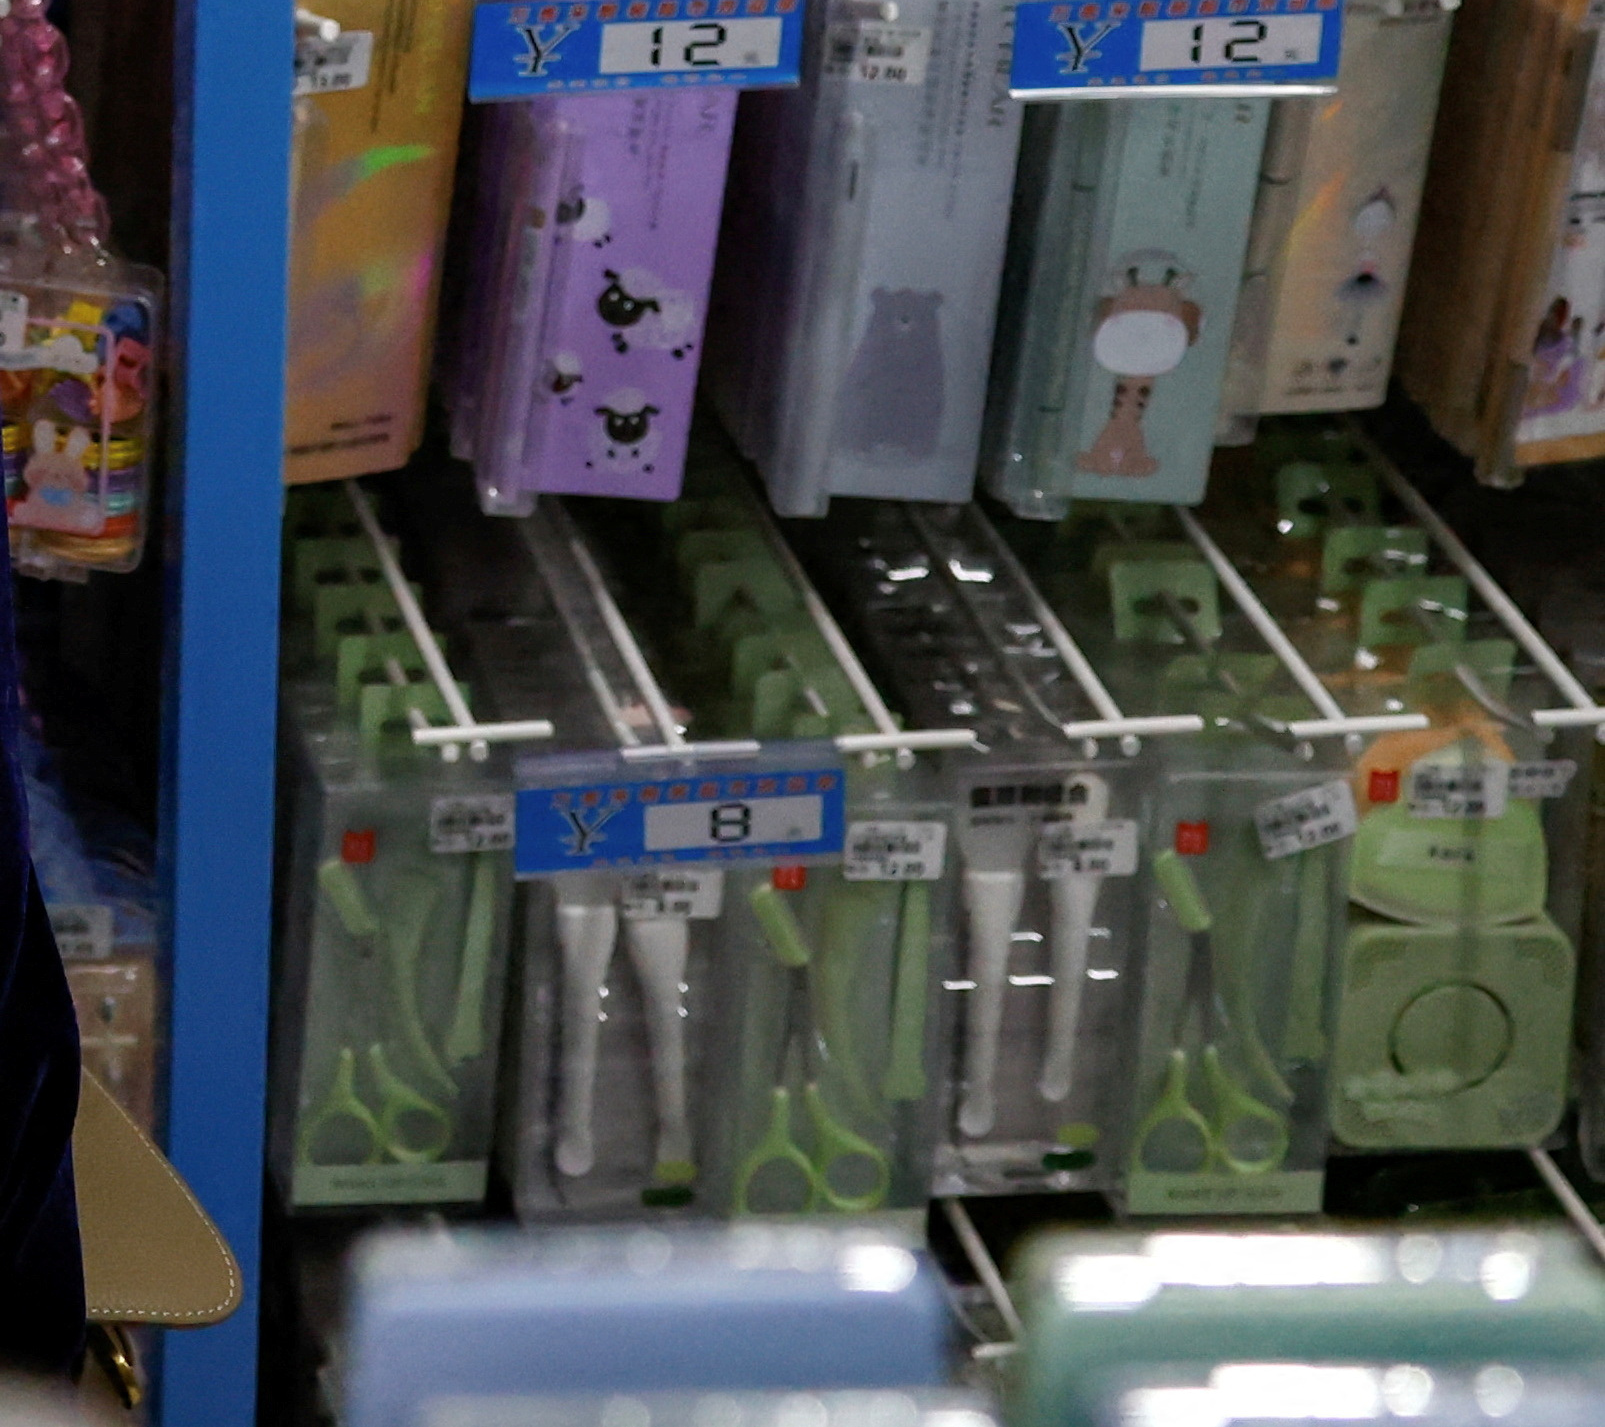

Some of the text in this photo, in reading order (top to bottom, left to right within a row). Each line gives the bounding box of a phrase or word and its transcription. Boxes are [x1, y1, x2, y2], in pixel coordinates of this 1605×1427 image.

[651, 22, 727, 67] 12
[1190, 19, 1268, 64] 12
[710, 802, 751, 842] 8
